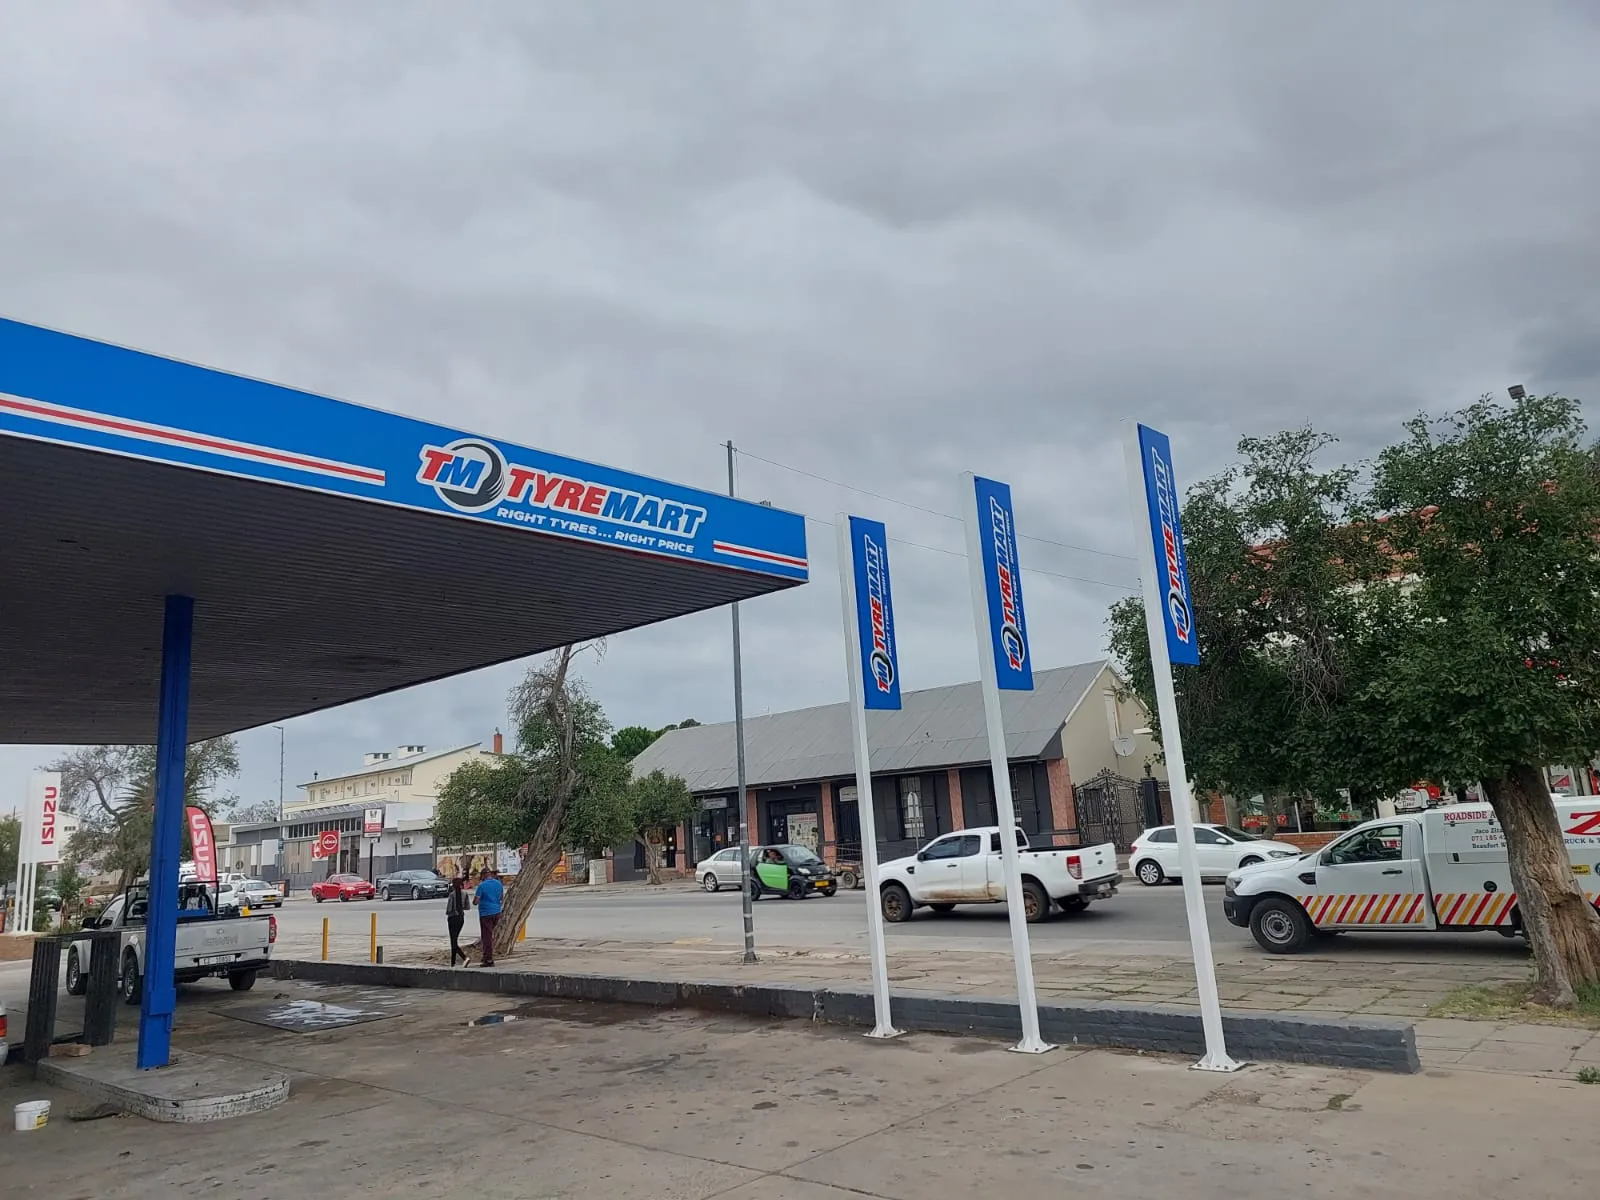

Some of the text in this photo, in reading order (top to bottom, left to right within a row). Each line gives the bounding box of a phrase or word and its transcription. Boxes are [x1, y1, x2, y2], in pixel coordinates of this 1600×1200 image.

[421, 449, 486, 490] TM
[496, 507, 695, 554] RIGHT TYRES... RIGHT PRICE
[507, 468, 704, 534] TYREMART
[1152, 447, 1180, 591] TYREMART
[990, 496, 1016, 626] TYREMART
[865, 535, 886, 652] TYREMART
[41, 786, 57, 845] ISUZU
[1443, 811, 1488, 821] ROADSIDE
